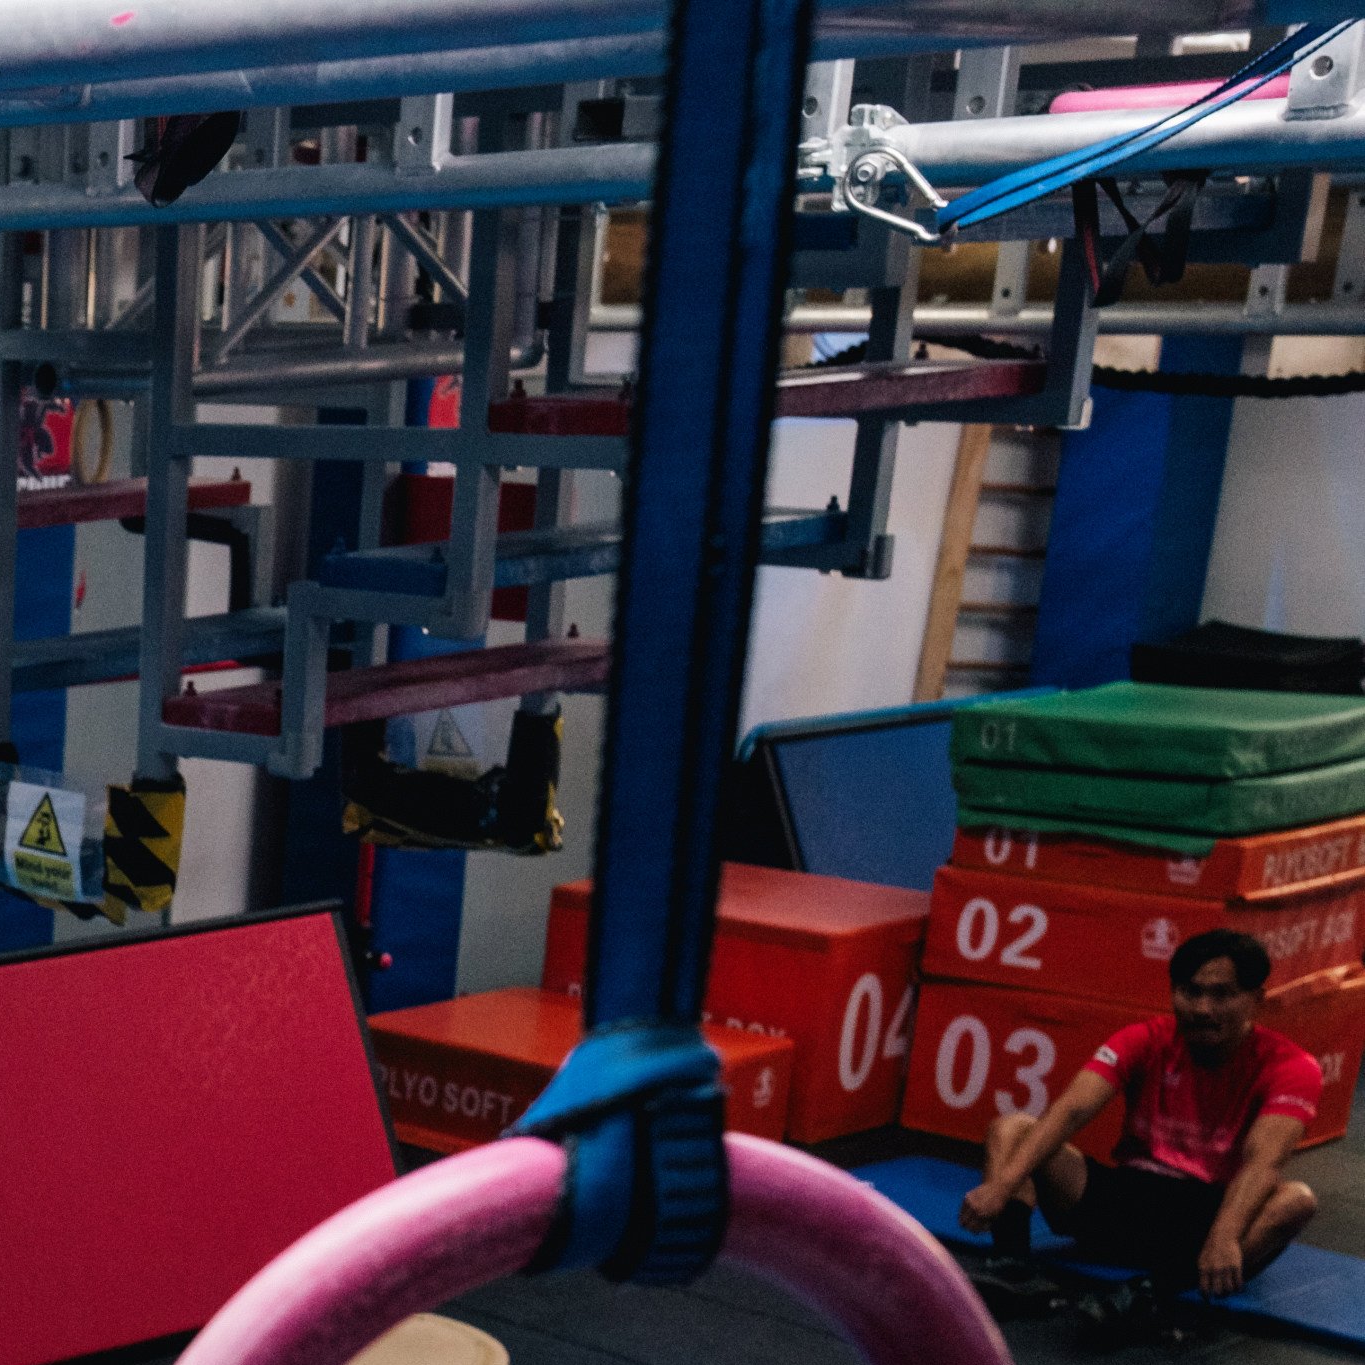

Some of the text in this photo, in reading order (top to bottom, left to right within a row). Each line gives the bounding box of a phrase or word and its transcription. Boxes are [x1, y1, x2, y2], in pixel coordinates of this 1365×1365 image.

[956, 897, 1049, 971] 02
[443, 1081, 514, 1125] SOFT
[935, 1015, 1057, 1120] 03
